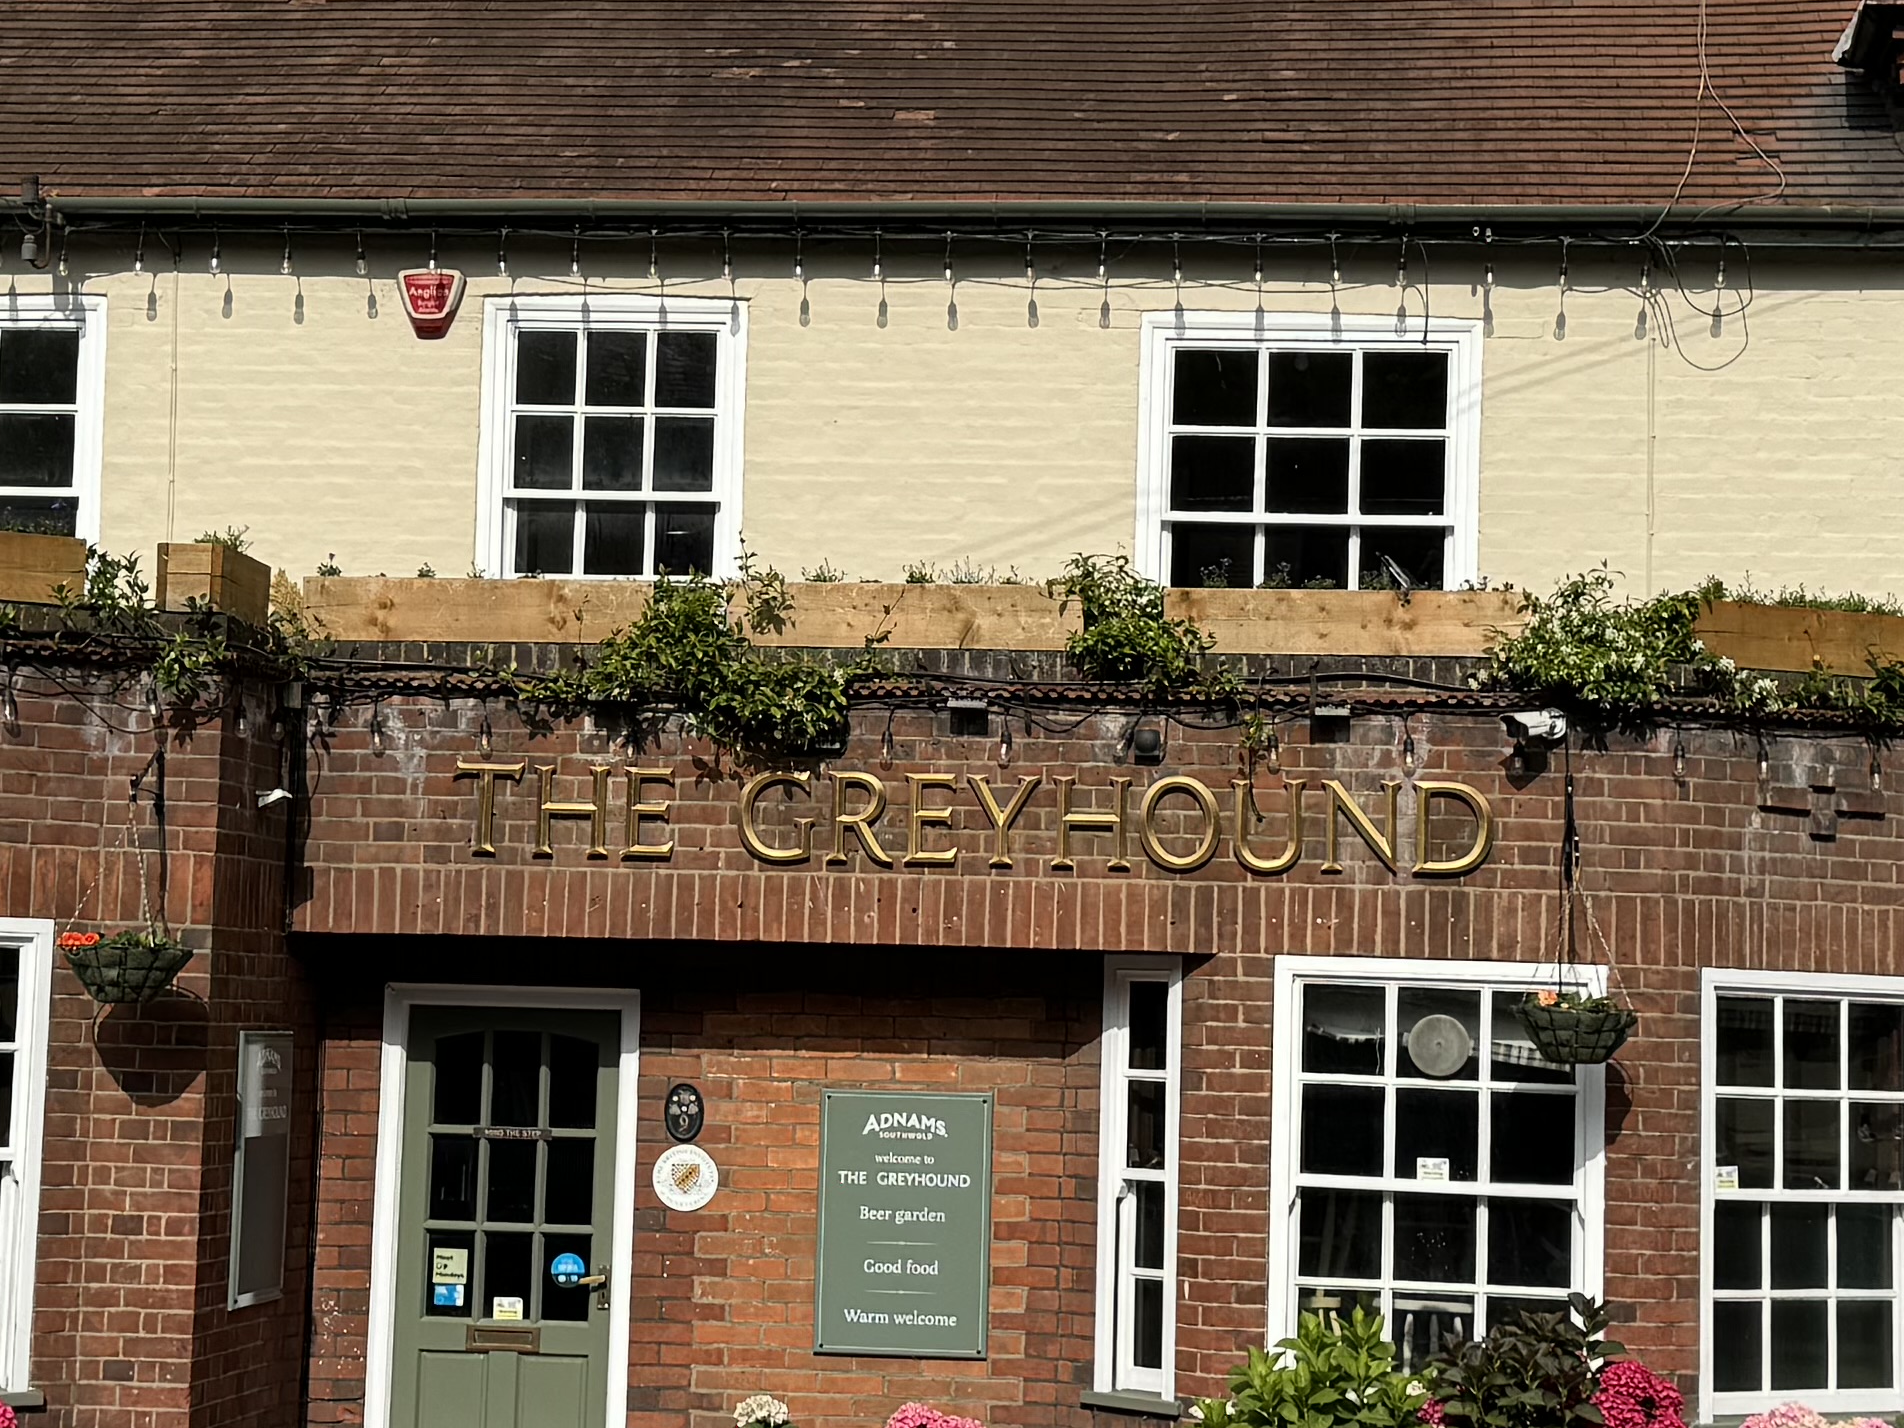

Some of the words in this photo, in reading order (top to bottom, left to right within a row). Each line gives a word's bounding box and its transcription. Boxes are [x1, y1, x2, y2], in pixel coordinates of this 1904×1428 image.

[456, 761, 675, 860] THE
[738, 771, 1494, 876] GREYHOUND
[679, 1114, 689, 1132] 9
[879, 1131, 933, 1140] SOUTHWOLD
[875, 1152, 921, 1164] welcome
[924, 1155, 935, 1164] to
[838, 1170, 867, 1185] THE
[876, 1172, 971, 1188] GREYHOUND
[860, 1206, 892, 1220] Beer
[895, 1207, 946, 1224] garden
[863, 1259, 902, 1273] Good
[906, 1259, 938, 1275] food
[844, 1309, 889, 1324] Warm
[893, 1310, 957, 1326] welcome
